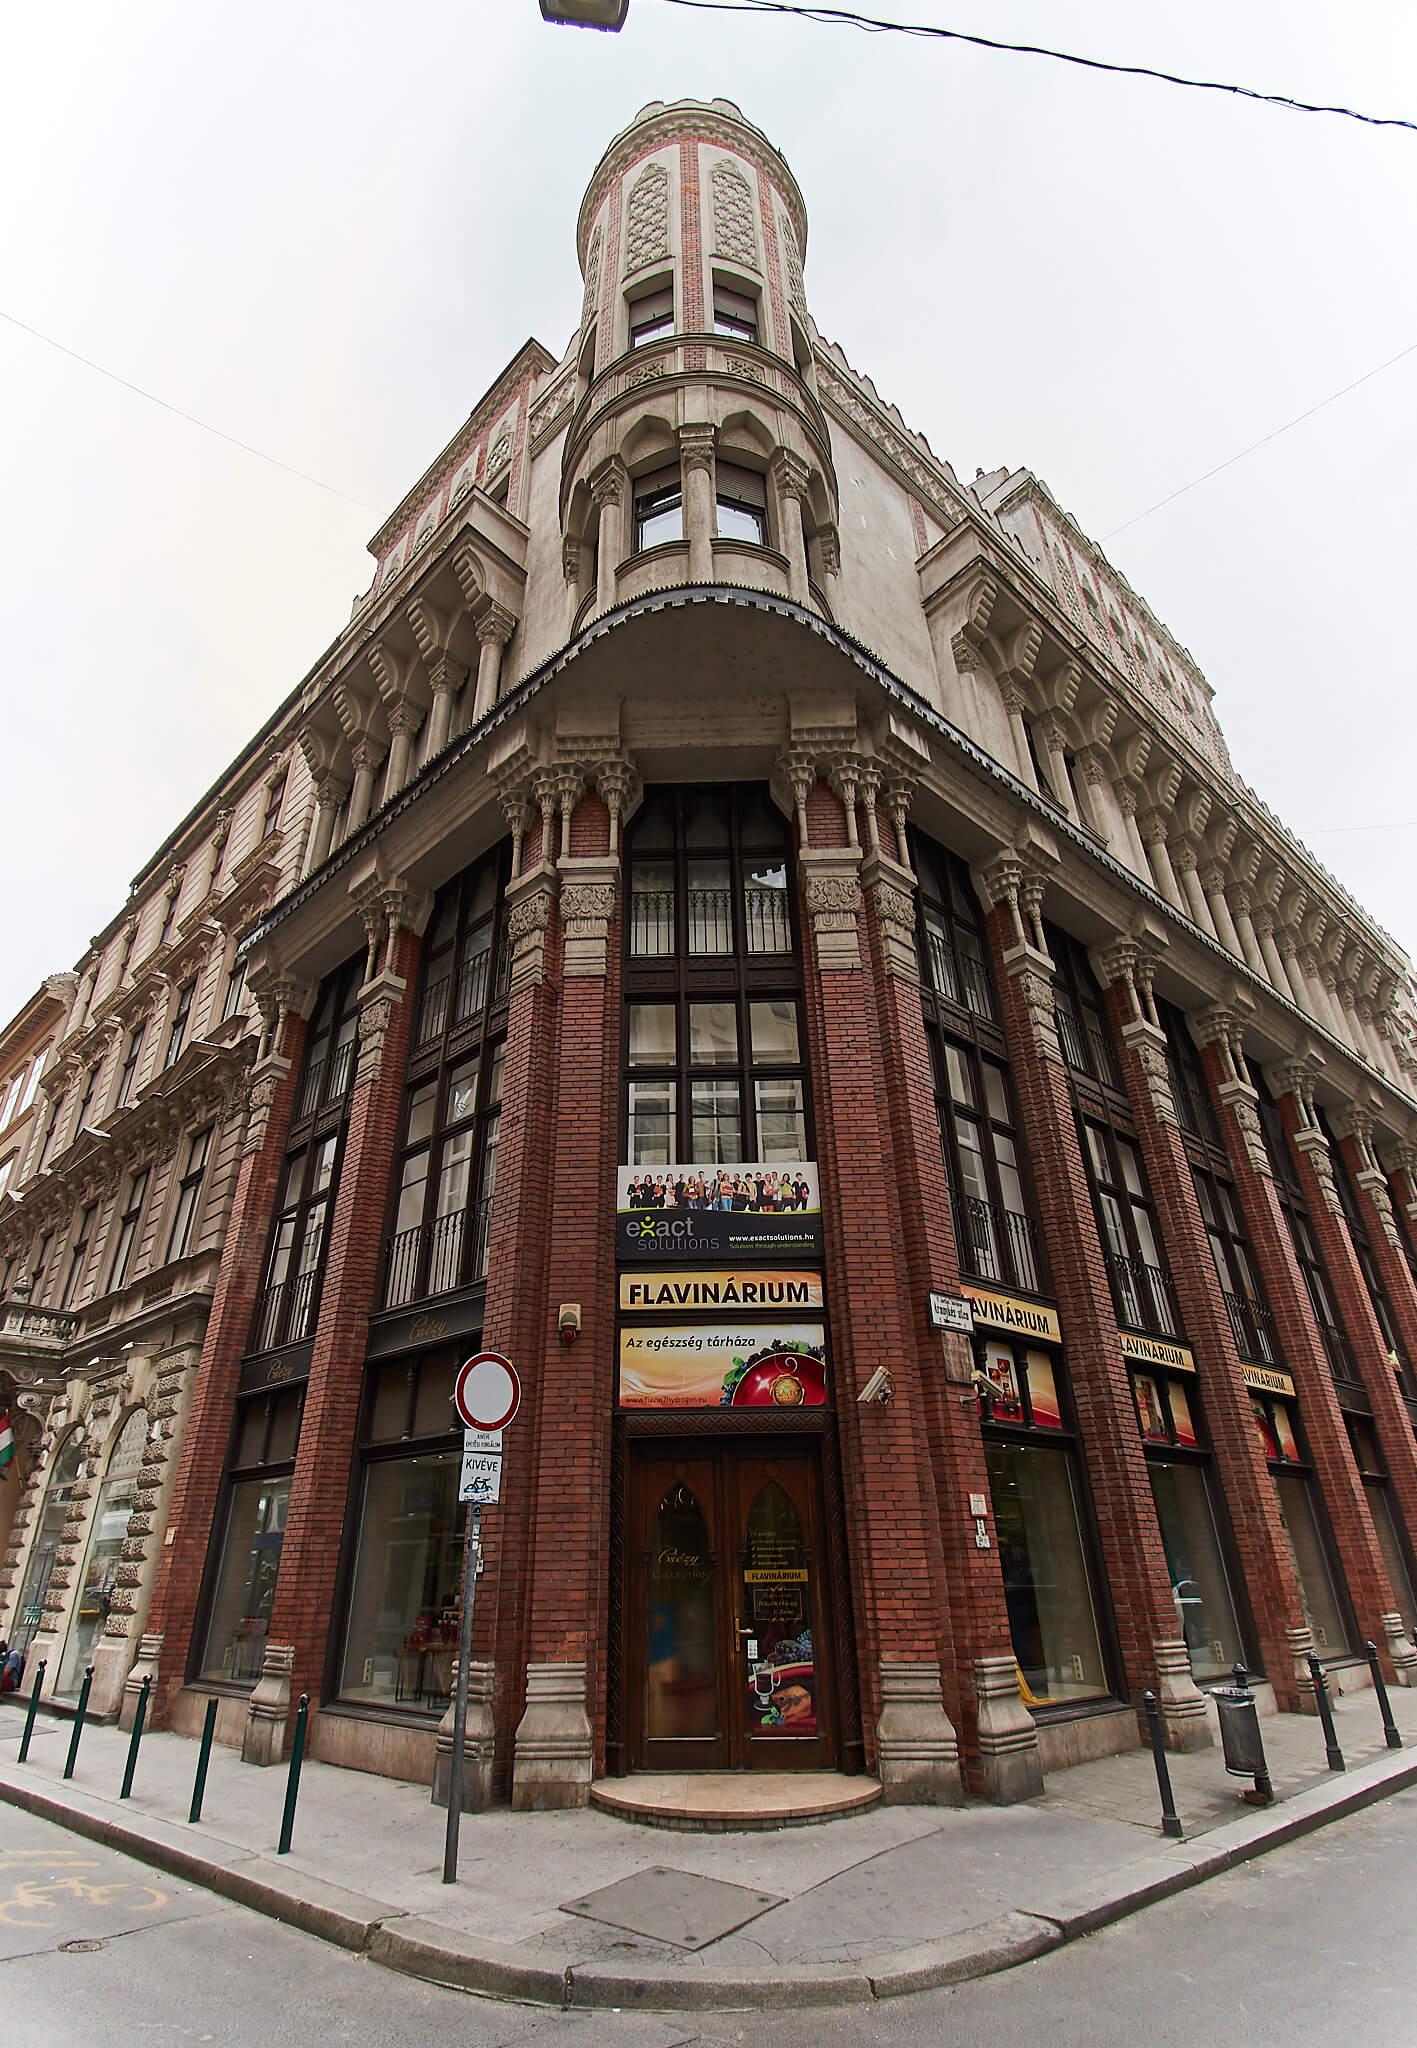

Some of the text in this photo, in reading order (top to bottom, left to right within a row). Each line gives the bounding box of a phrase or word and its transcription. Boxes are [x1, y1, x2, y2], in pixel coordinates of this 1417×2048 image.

[626, 1216, 694, 1238] exact
[638, 1233, 720, 1251] solutions
[728, 1233, 815, 1242] www.exactsolutions.hu
[629, 1277, 809, 1305] FLAVINÁRIUM
[971, 1296, 1050, 1335] AVINÁRIUM
[626, 1335, 756, 1351] Az egészség tárháza
[1119, 1334, 1185, 1367] LAVINÁRIUM
[1242, 1367, 1287, 1391] AVINÁRIUM
[465, 1458, 499, 1472] KIVÉVE
[751, 1570, 801, 1580] FLAVINÁRIUM
